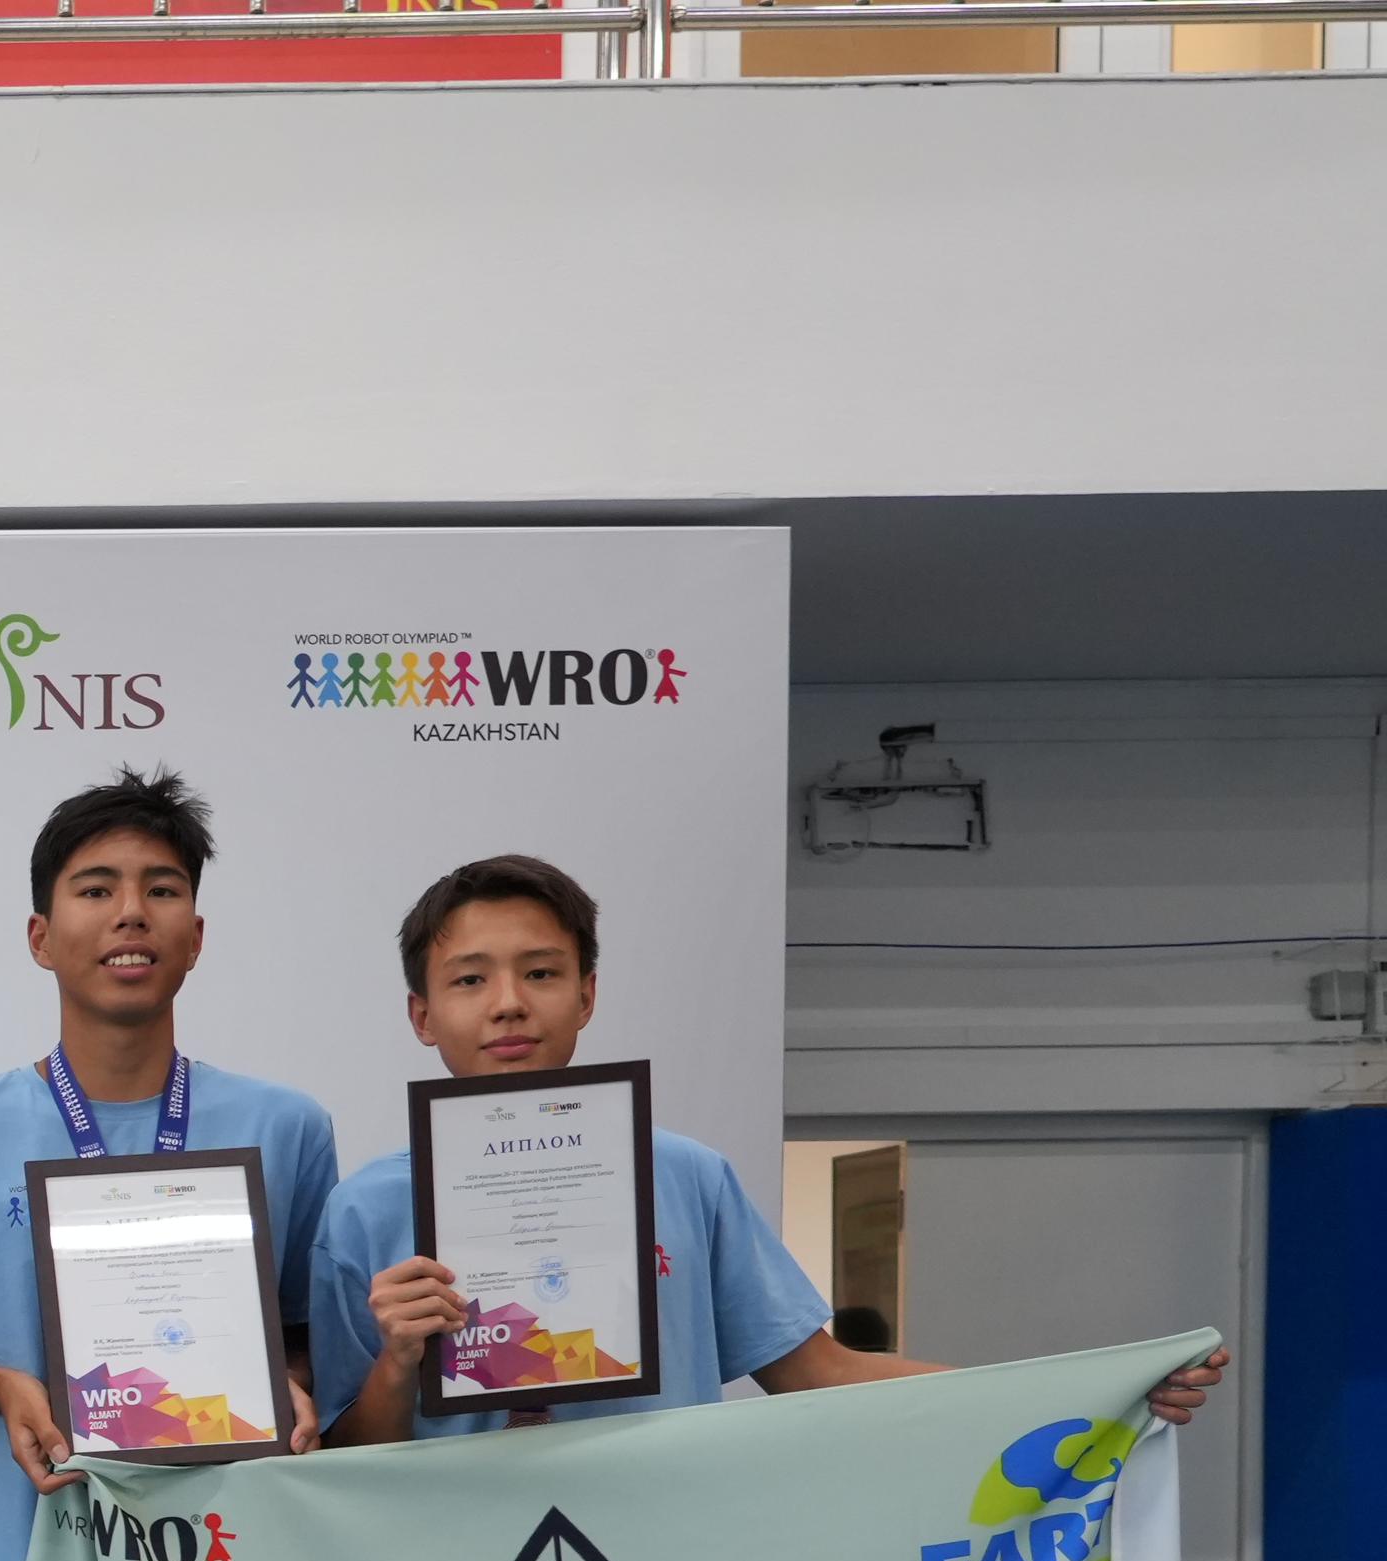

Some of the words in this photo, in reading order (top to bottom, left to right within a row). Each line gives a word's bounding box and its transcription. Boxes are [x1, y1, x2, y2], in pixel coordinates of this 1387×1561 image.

[295, 634, 341, 645] WORLD
[345, 634, 389, 645] ROBOT
[33, 673, 165, 731] NIS
[413, 723, 560, 741] KAZAKHSTAN
[483, 1134, 582, 1157] ДИПЛОМ
[452, 1323, 511, 1348] WRO
[456, 1348, 490, 1360] ALMATY
[456, 1360, 475, 1371] 2024
[81, 1386, 142, 1408] WRO
[88, 1409, 122, 1420] ALMATY
[89, 1420, 108, 1430] 2024
